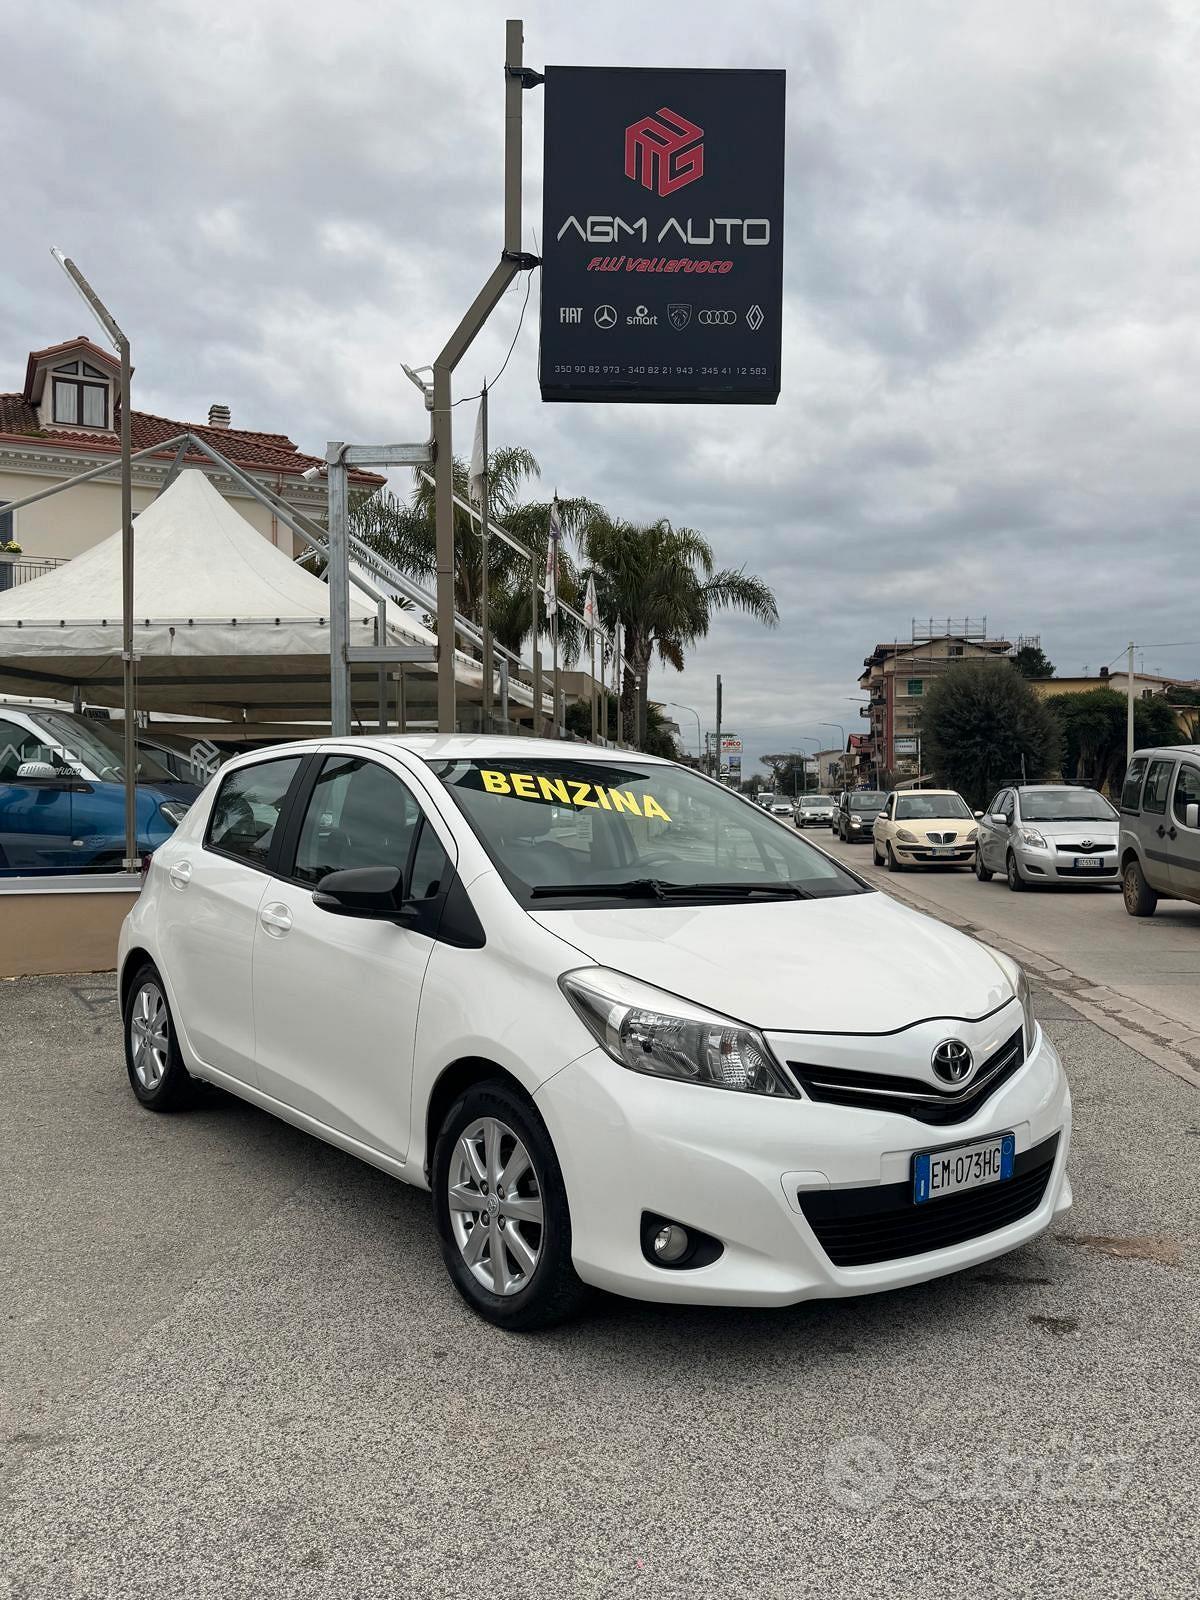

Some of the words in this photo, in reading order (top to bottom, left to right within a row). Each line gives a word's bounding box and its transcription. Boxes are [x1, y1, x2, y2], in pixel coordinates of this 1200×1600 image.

[557, 215, 648, 243] AGM
[657, 216, 770, 246] AUTO
[559, 307, 583, 324] FIAT
[626, 315, 659, 325] smart
[554, 365, 572, 374] 350
[574, 365, 586, 374] 90
[588, 365, 600, 374] 82
[603, 365, 620, 374] 973
[628, 366, 645, 375] 340
[647, 366, 660, 375] 82
[662, 366, 673, 375] 21
[676, 366, 693, 375] 943
[701, 366, 719, 375] 345
[721, 367, 732, 375] 41
[736, 367, 747, 376] 12
[749, 367, 767, 376] 583
[0, 743, 82, 763] AUTO
[480, 770, 672, 823] BENZINA
